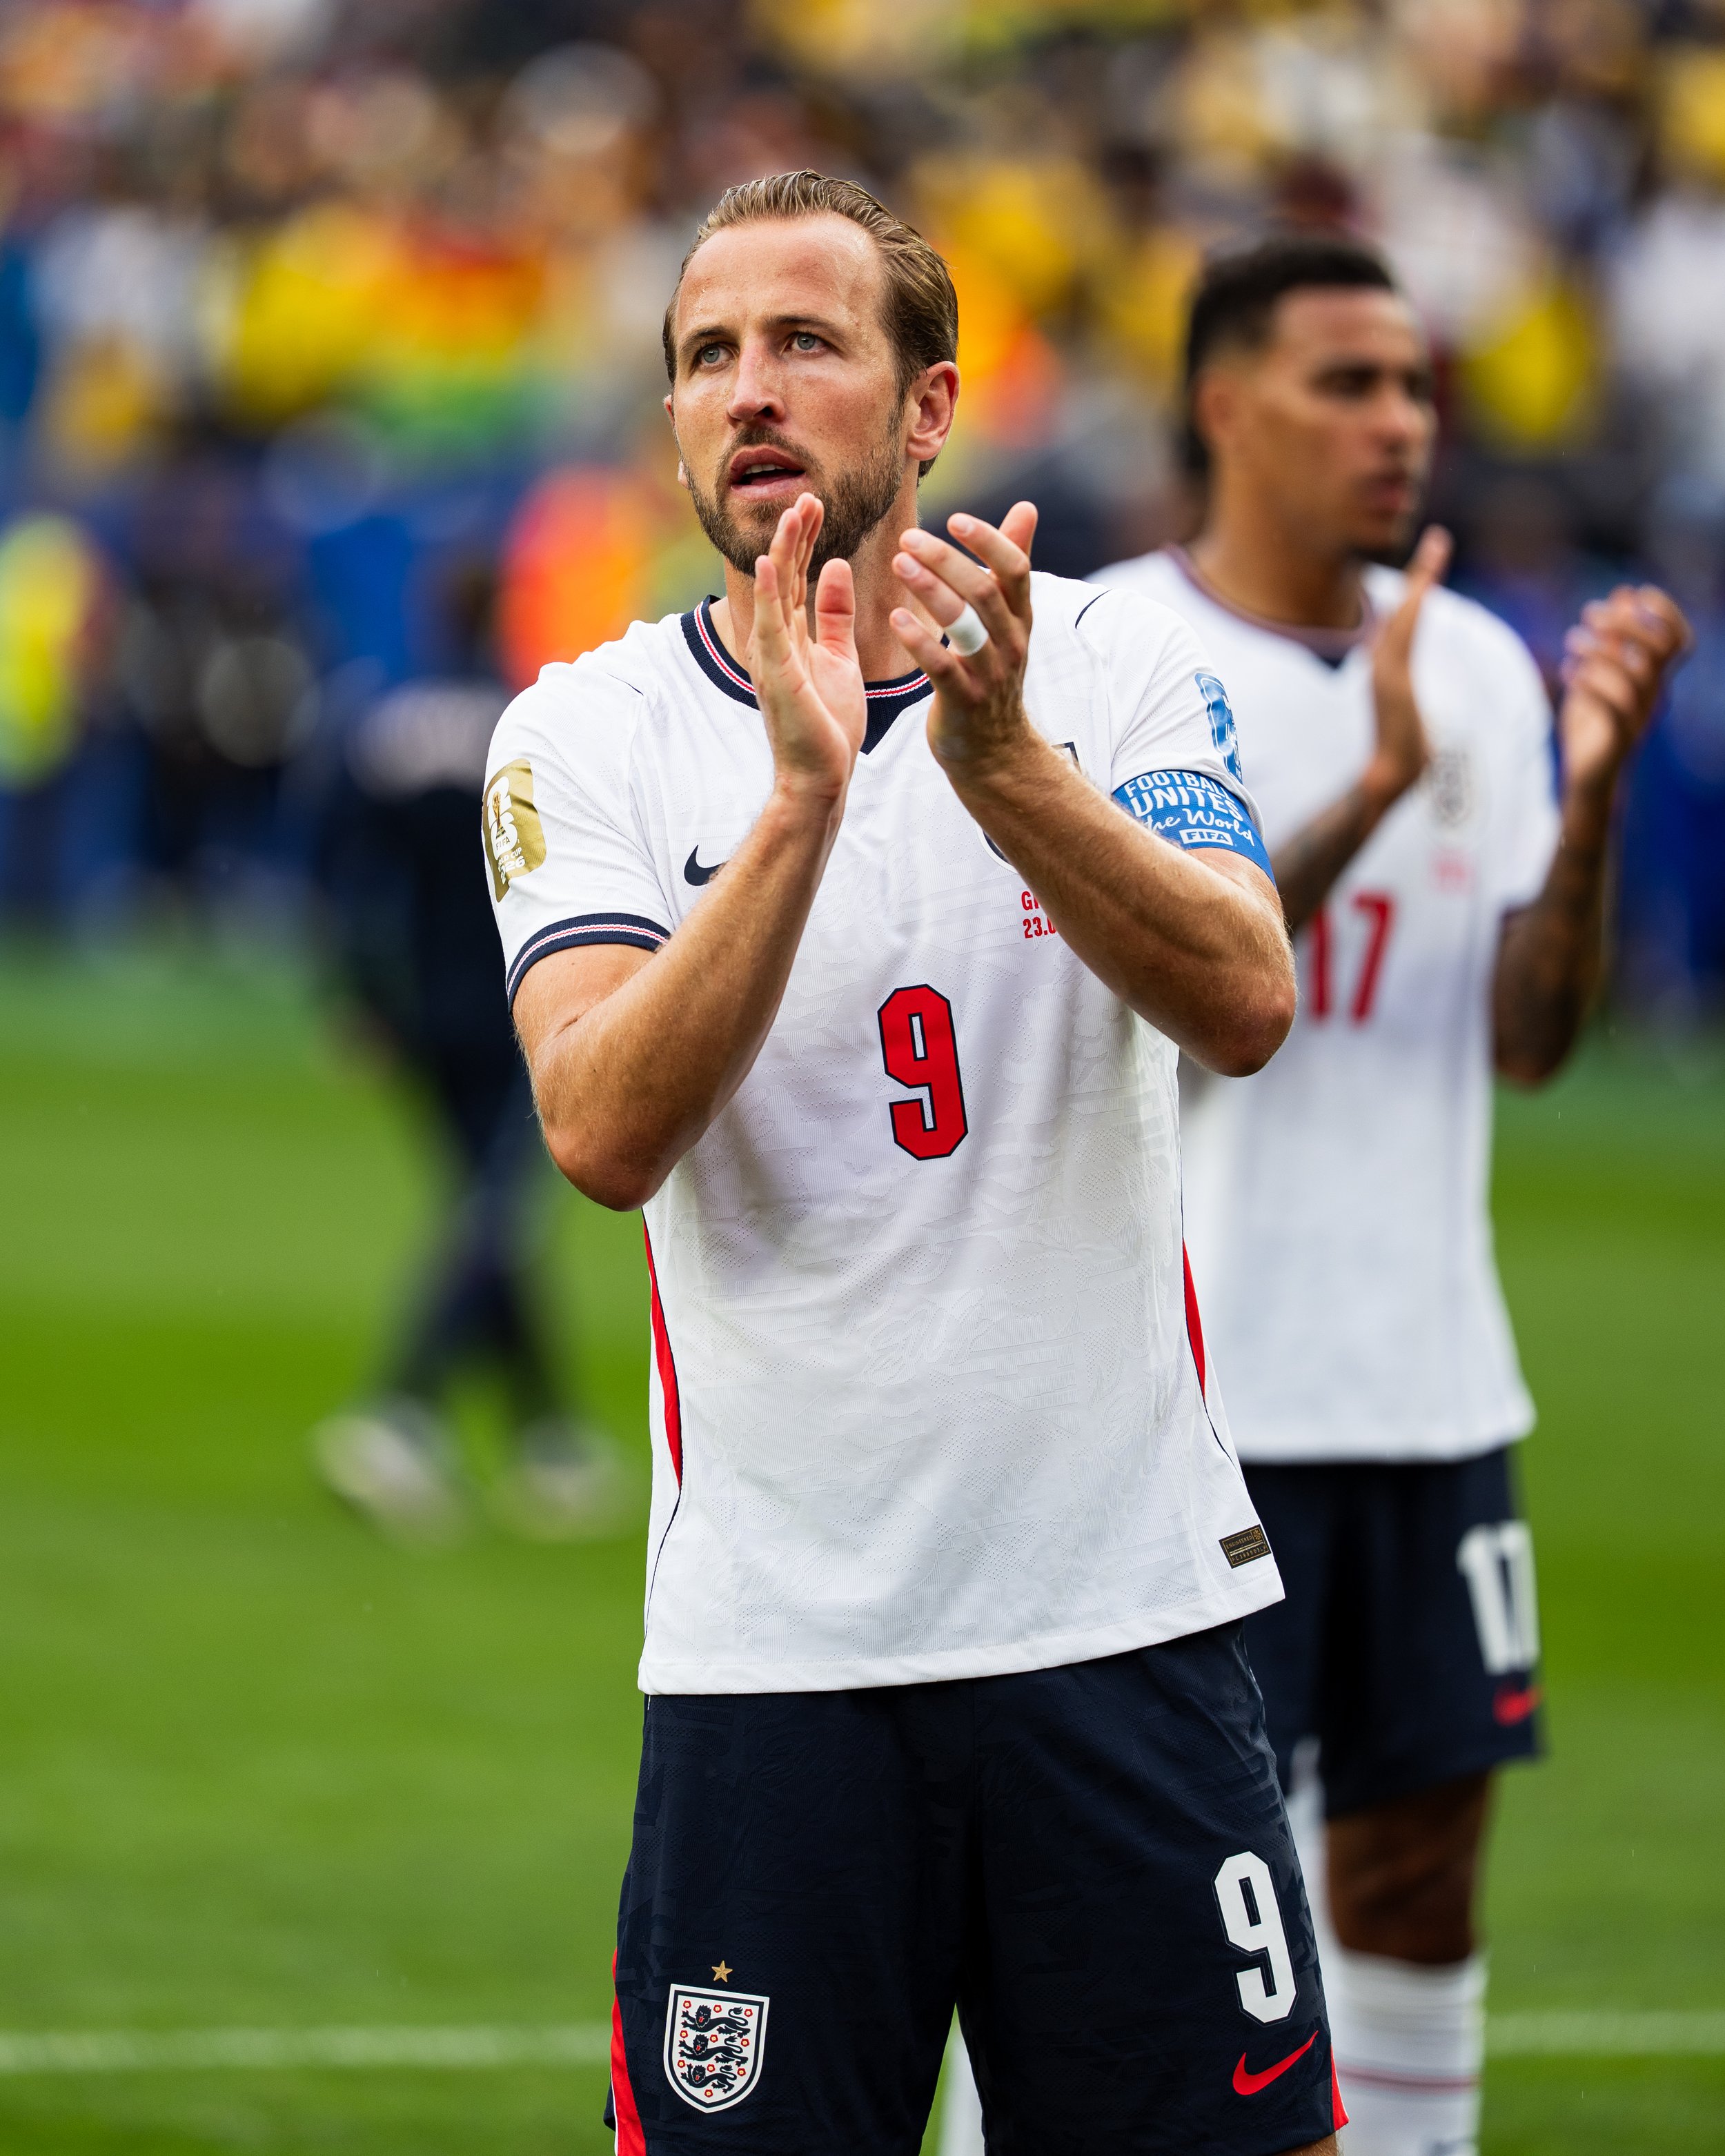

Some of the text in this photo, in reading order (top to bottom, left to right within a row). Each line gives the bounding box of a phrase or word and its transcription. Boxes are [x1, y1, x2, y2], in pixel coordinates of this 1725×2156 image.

[1124, 771, 1235, 804] FOOTBALL
[1130, 787, 1243, 822] UNITES
[496, 836, 511, 851] FIFA
[1143, 808, 1255, 847] the World
[1185, 830, 1230, 843] FIFA
[511, 847, 522, 859] CUP
[876, 983, 969, 1161] 9
[1214, 1850, 1297, 2024] 9
